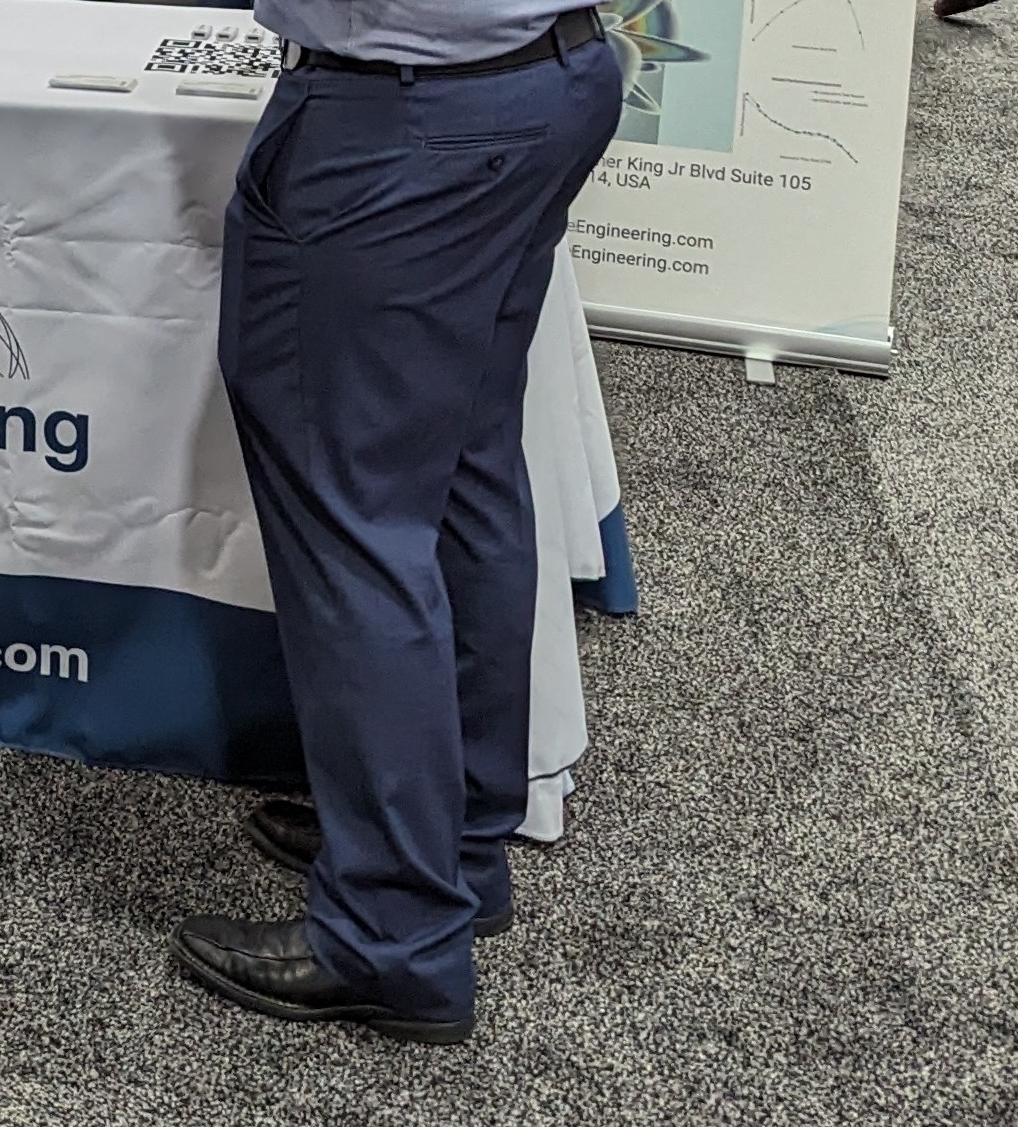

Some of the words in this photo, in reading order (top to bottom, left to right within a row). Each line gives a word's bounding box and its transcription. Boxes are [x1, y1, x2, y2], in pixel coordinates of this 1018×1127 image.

[590, 170, 612, 188] 14,
[616, 172, 651, 190] USA
[627, 156, 664, 178] King
[668, 161, 686, 177] Jr
[690, 163, 726, 182] Blvd
[730, 168, 774, 187] Suite
[779, 174, 812, 191] 105
[570, 244, 710, 276] Engineering.com
